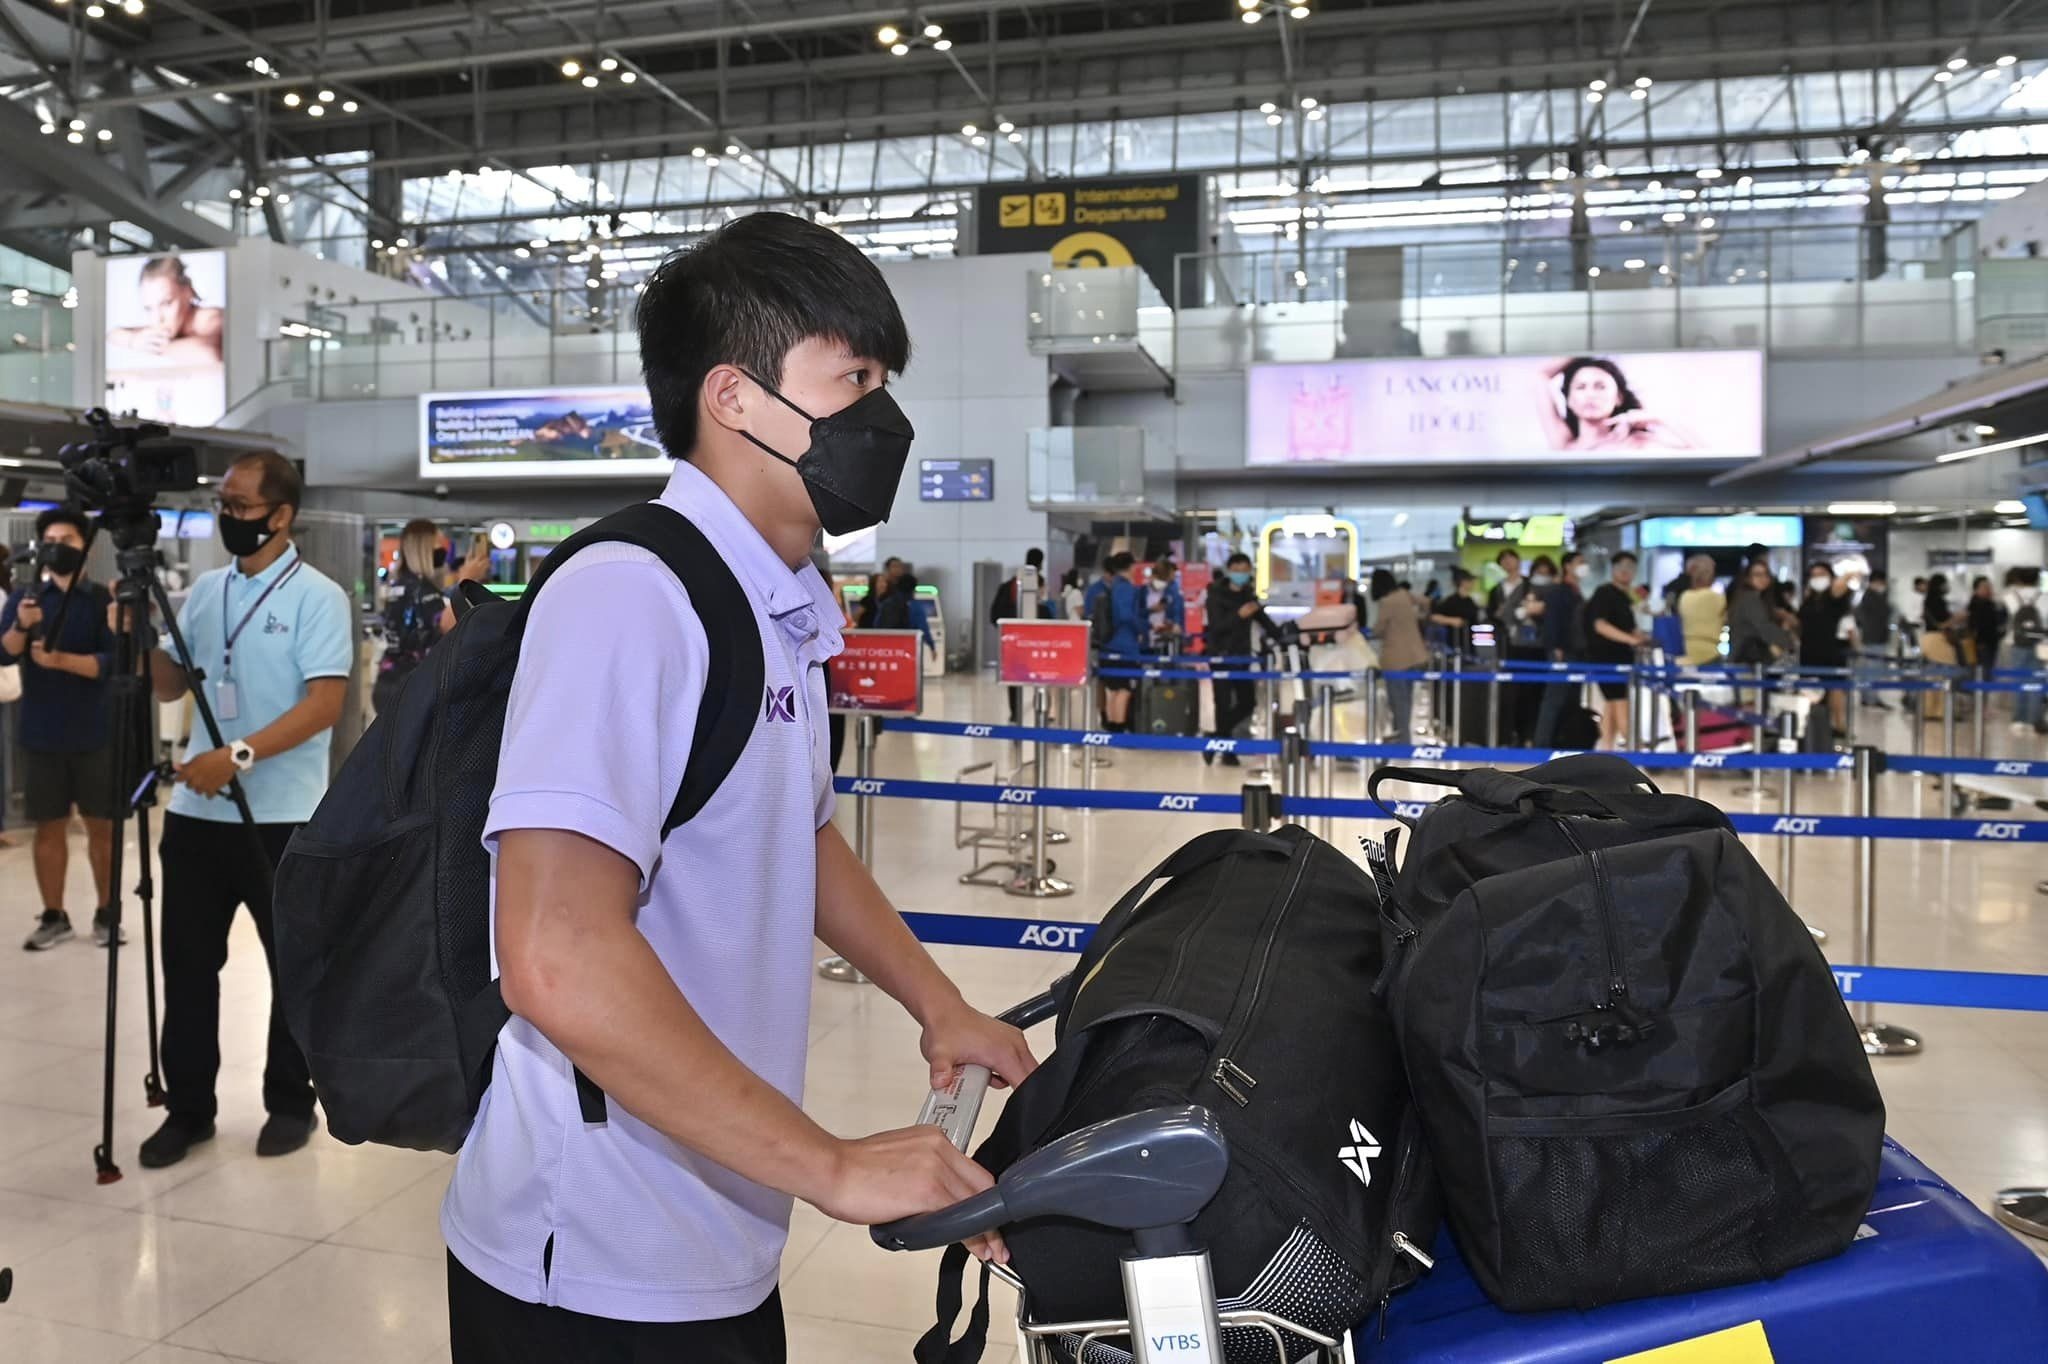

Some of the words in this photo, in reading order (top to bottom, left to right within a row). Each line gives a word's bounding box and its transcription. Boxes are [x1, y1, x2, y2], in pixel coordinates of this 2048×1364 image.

[1075, 184, 1178, 203] International
[1074, 206, 1167, 225] Departures
[964, 725, 992, 737] AOT
[1082, 733, 1112, 745] AOT
[1205, 739, 1238, 752] AOT
[1412, 747, 1446, 760] AOT
[1691, 755, 1726, 768] AOT
[1995, 762, 2033, 775] AOT
[851, 780, 886, 793] AOT
[1000, 789, 1036, 804] AOT
[1159, 796, 1199, 810] AOT
[1773, 818, 1820, 834] AOT
[1976, 824, 2025, 839] AOT
[1019, 925, 1085, 948] AOT
[1151, 1333, 1201, 1352] VTBS
